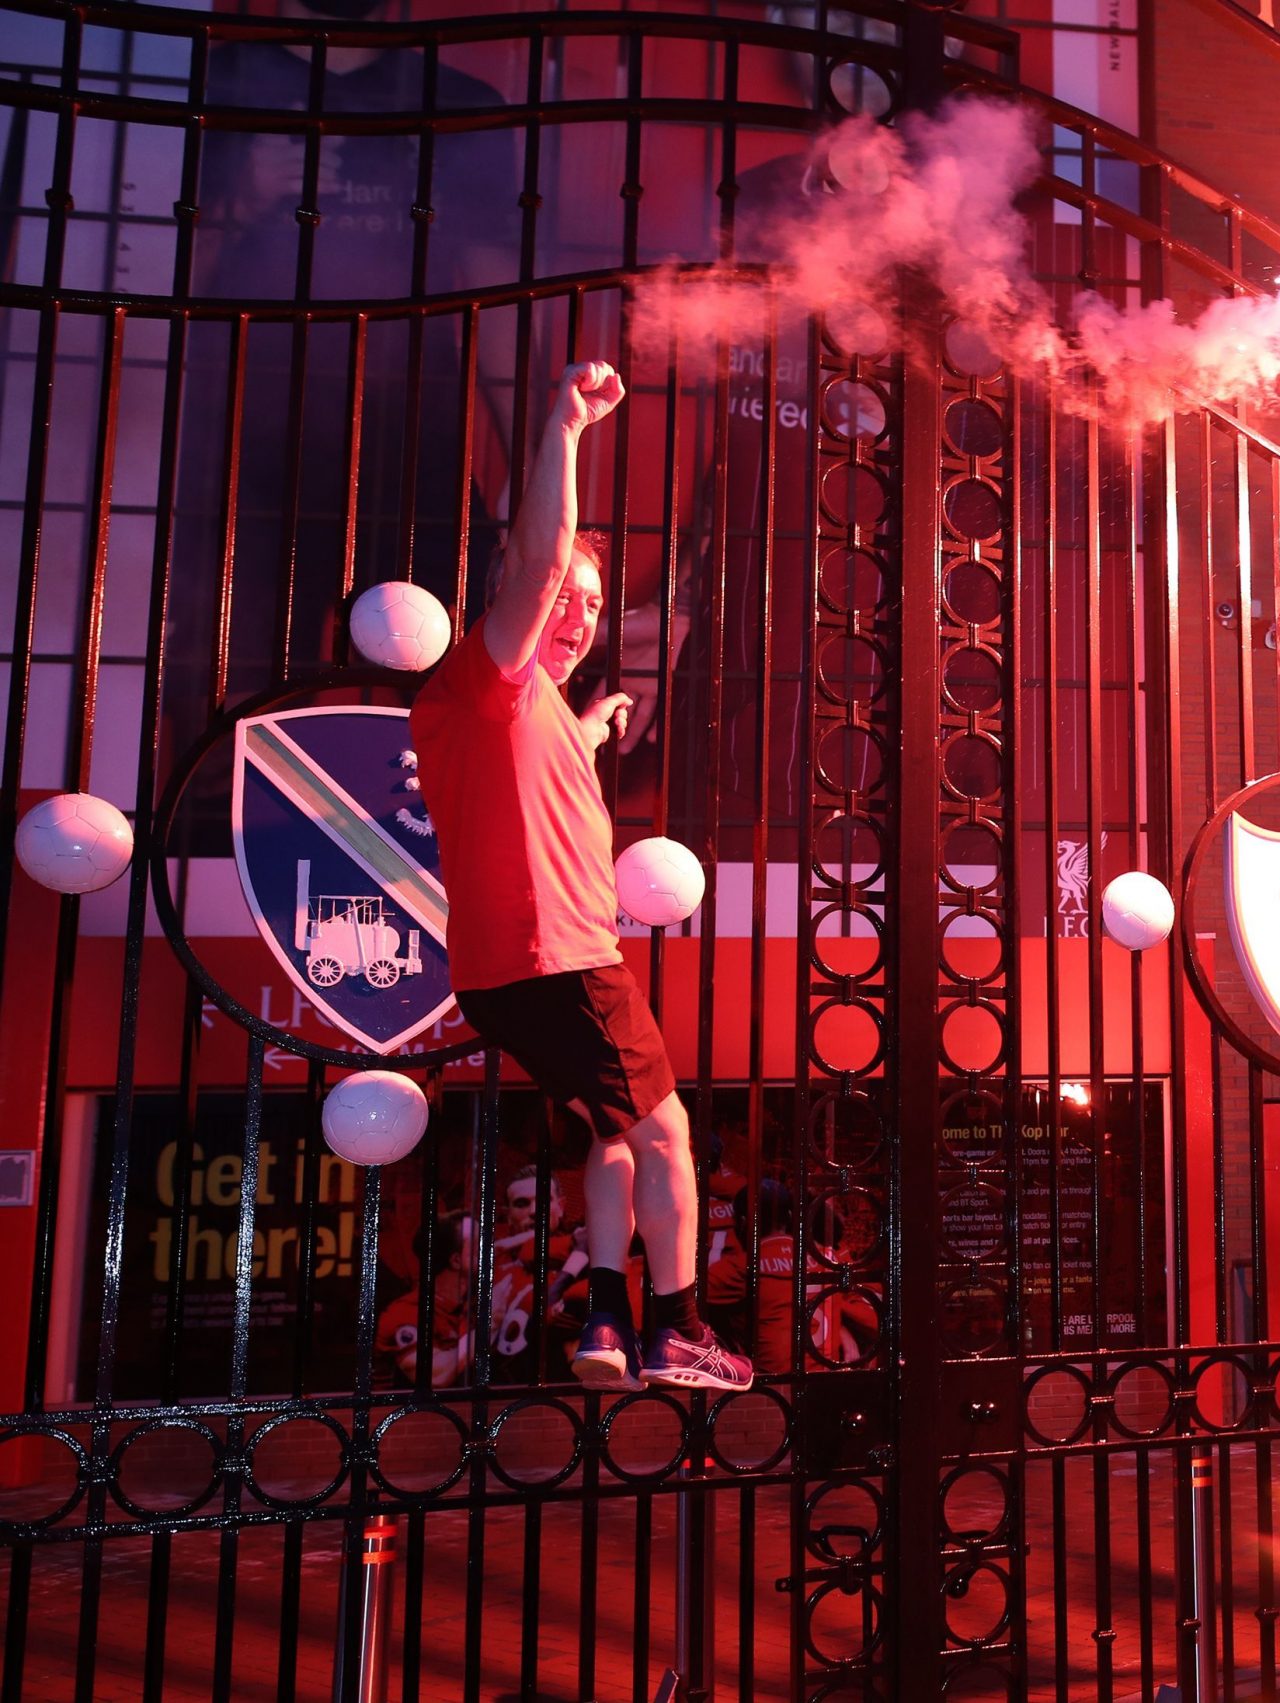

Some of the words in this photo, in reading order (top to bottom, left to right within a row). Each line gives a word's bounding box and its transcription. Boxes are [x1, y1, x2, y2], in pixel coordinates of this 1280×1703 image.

[973, 1126, 987, 1141] to
[156, 1139, 278, 1208] Get
[294, 1137, 357, 1205] in
[149, 1211, 355, 1283] there!
[1068, 1314, 1086, 1326] ARE
[1110, 1323, 1136, 1335] MORE
